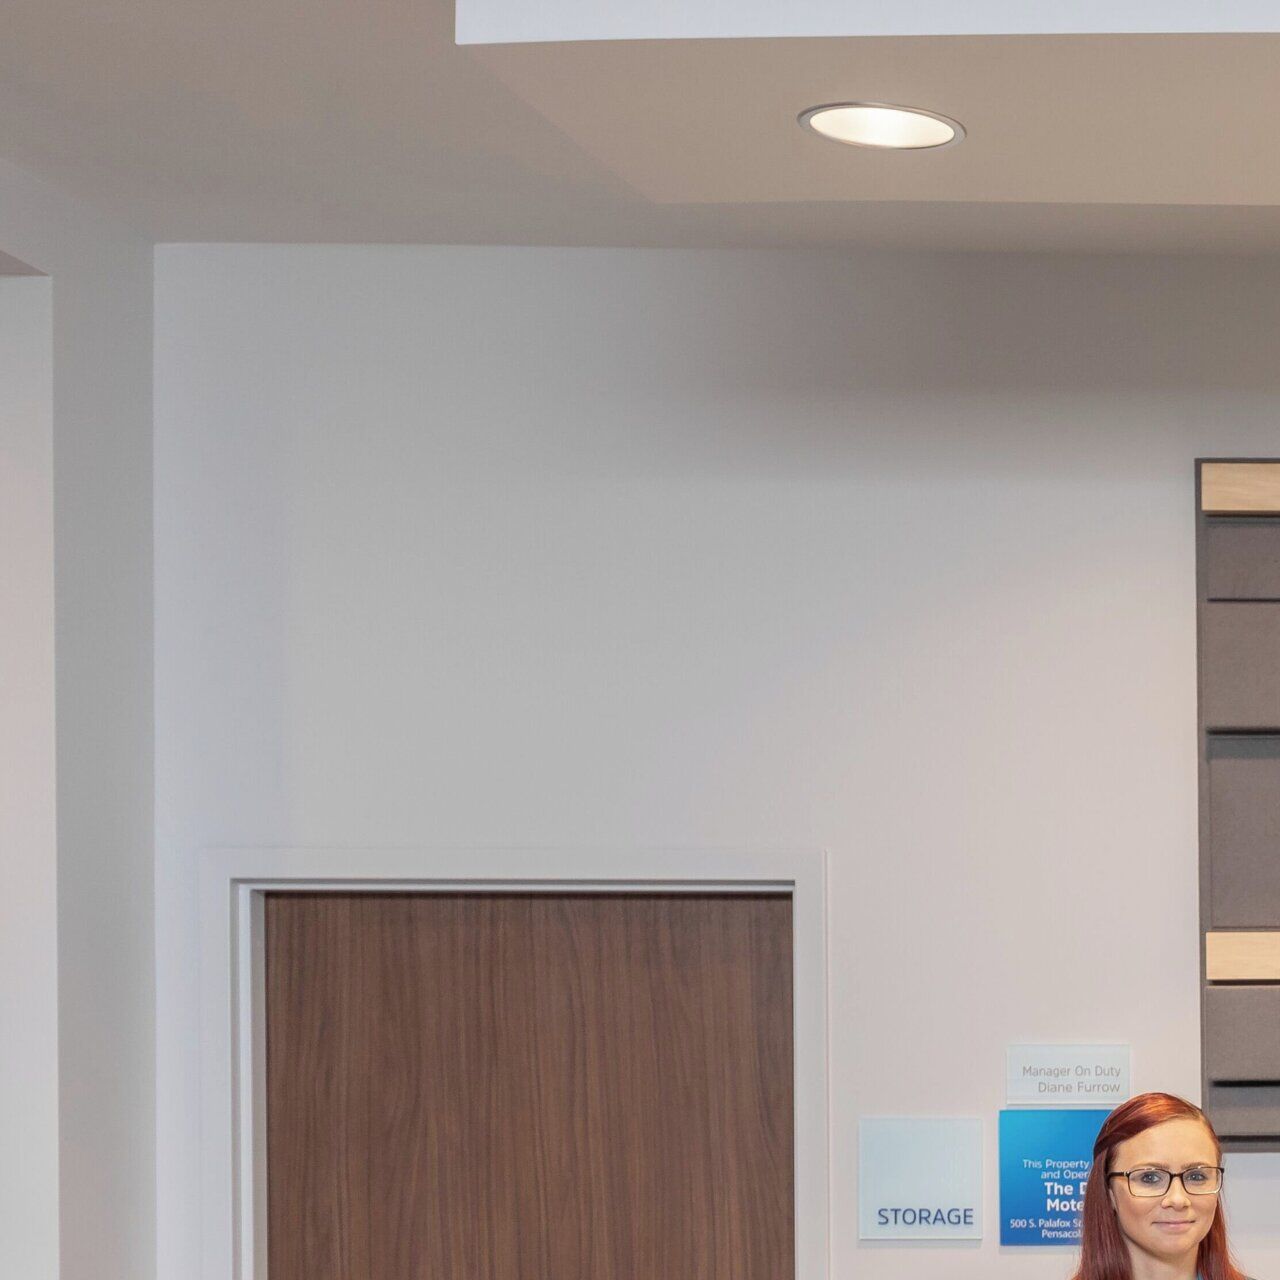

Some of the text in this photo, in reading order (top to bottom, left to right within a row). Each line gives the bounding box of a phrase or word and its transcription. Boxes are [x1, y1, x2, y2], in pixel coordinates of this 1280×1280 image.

[1022, 1065, 1121, 1078] Manager On Duty
[1038, 1081, 1121, 1093] Diane Furrow
[1022, 1159, 1090, 1170] This Property
[1041, 1170, 1090, 1180] and Oper
[1044, 1182, 1074, 1196] The
[877, 1207, 974, 1226] STORAGE
[1010, 1218, 1027, 1229] 500
[1028, 1218, 1037, 1228] S.
[1038, 1218, 1071, 1228] Palafox
[1041, 1229, 1082, 1239] Pensacol
